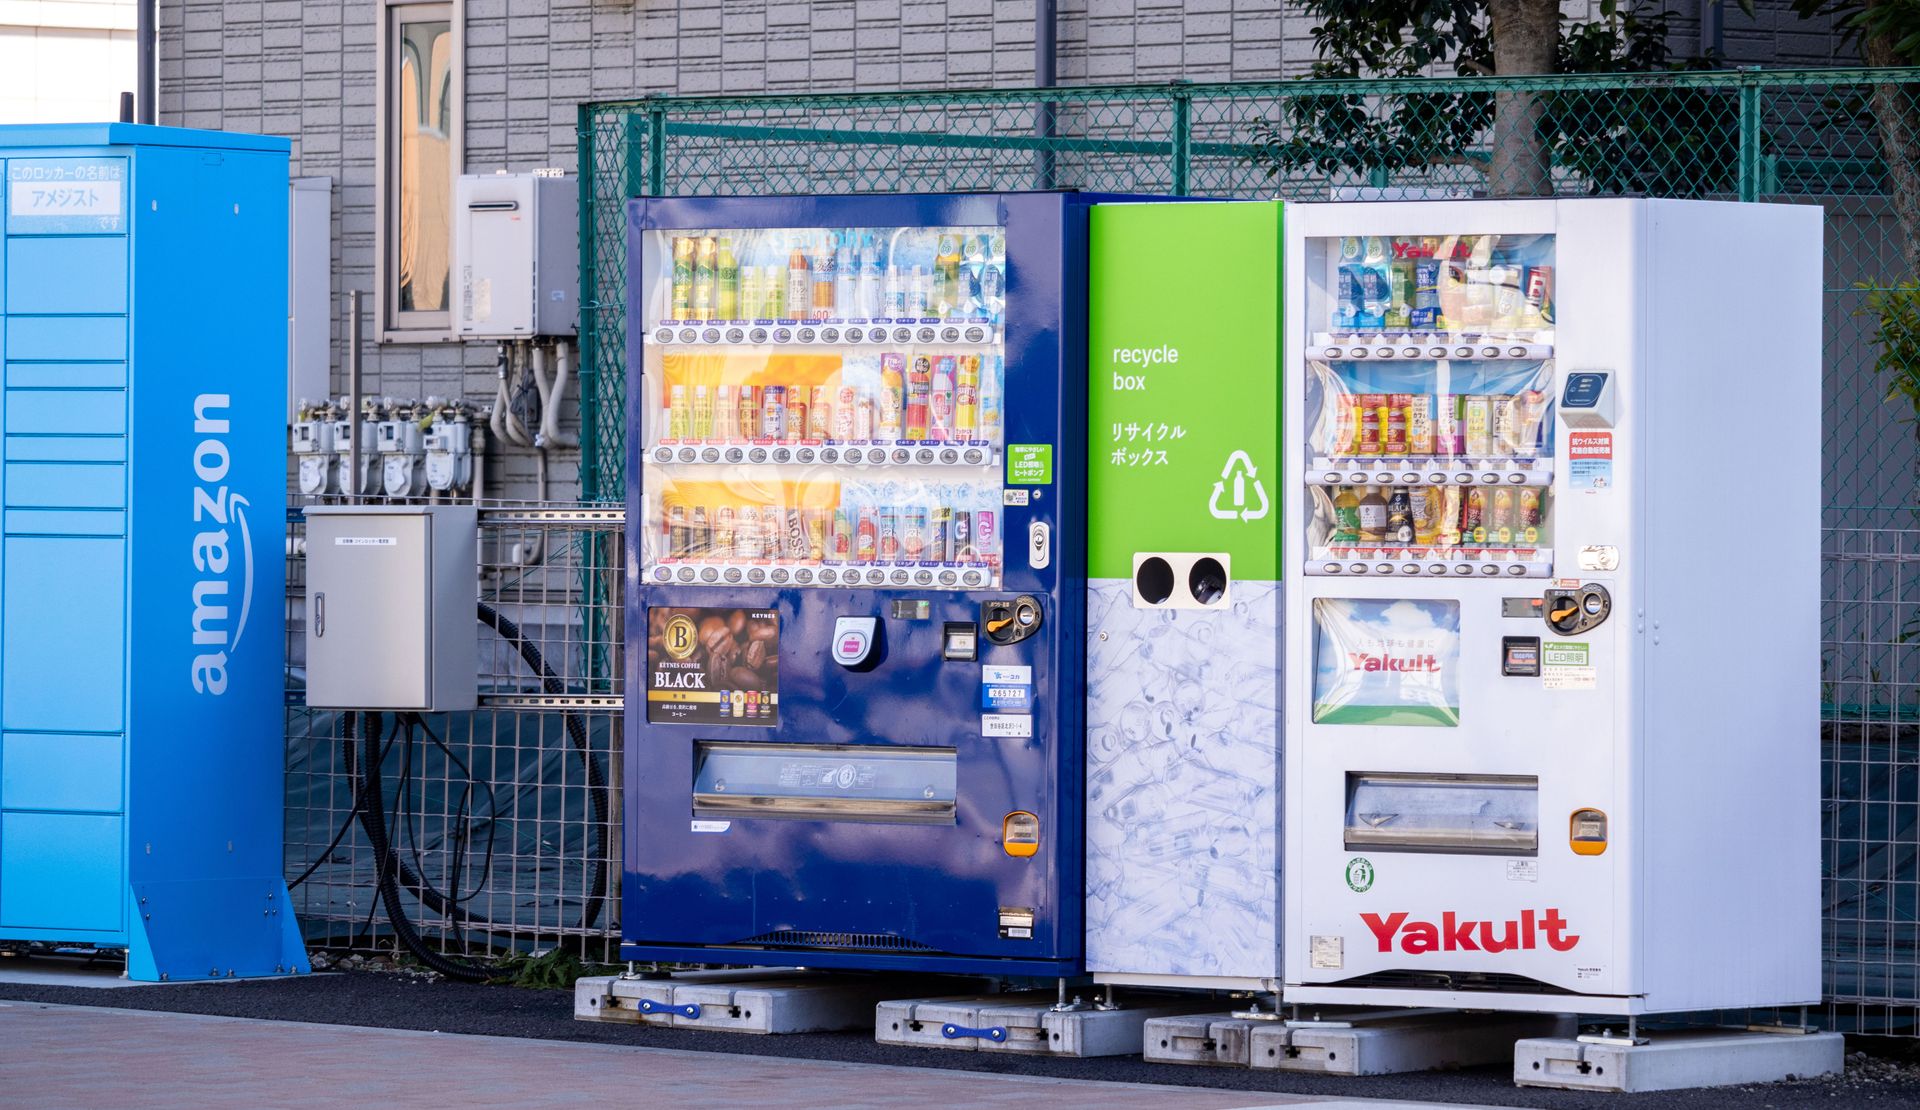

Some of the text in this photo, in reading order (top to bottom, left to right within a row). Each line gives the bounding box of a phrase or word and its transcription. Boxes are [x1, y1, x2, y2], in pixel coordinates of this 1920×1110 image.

[12, 165, 120, 180] このロッカーの名前は
[31, 188, 99, 208] アメジスト
[99, 216, 120, 229] です
[1113, 344, 1179, 368] recycle
[1113, 371, 1146, 391] box
[1112, 422, 1187, 442] リサイクル
[1111, 447, 1169, 466] ボックス
[191, 394, 230, 696] amazon
[788, 517, 805, 558] BOSS
[673, 626, 688, 648] B
[1349, 653, 1441, 672] Yakult
[1548, 652, 1584, 663] LED照明
[654, 671, 706, 688] BLACK
[1358, 908, 1581, 955] Yakult
